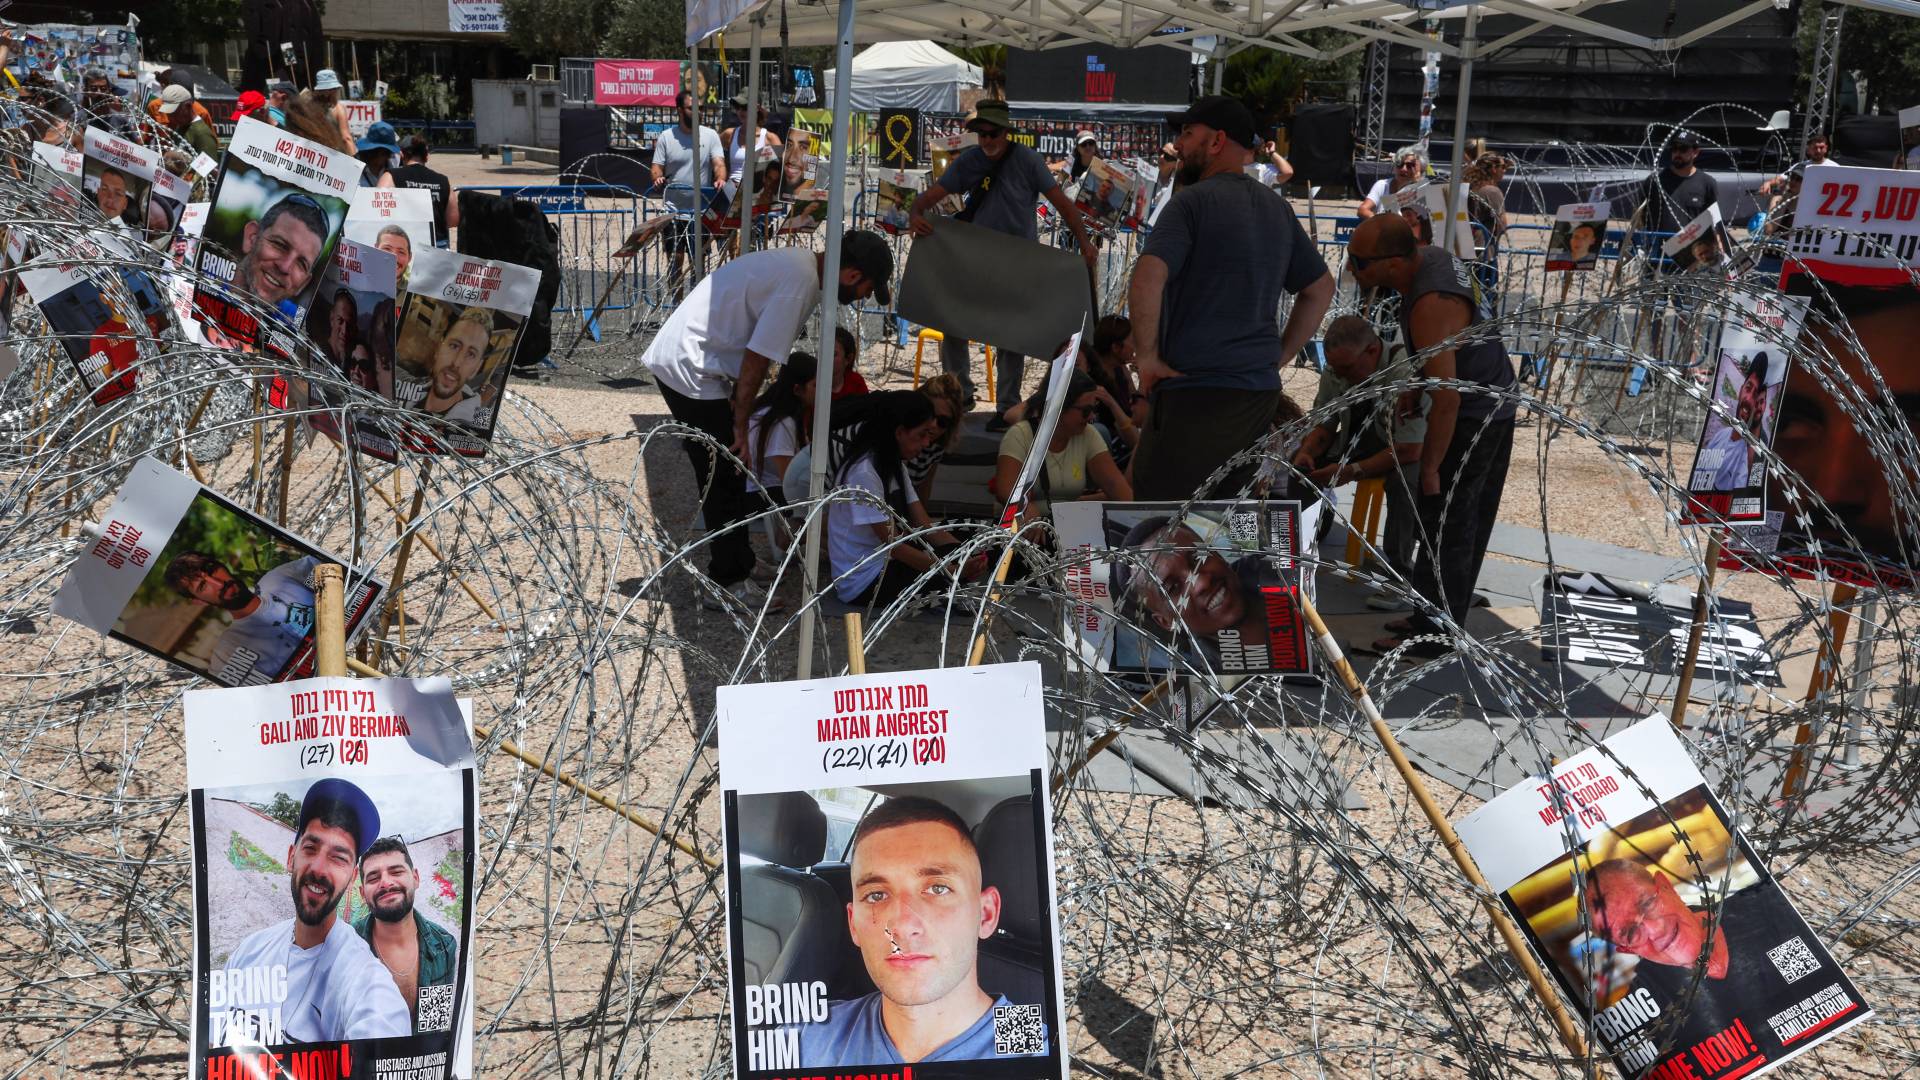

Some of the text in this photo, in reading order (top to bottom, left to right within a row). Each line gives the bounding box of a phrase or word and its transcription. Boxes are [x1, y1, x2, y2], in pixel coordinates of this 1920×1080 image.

[275, 138, 294, 157] (42)
[316, 152, 328, 169] טל
[1817, 182, 1859, 217] 22
[202, 251, 236, 281] BRING
[456, 273, 481, 289] ELKANA
[78, 351, 109, 376] BRING
[107, 526, 143, 569] GUY ILOUZ
[128, 546, 152, 567] (26)
[1260, 585, 1297, 669] HOME NOW!
[1218, 629, 1240, 670] BRING
[1244, 644, 1269, 670] HIM
[217, 647, 259, 687] BRING
[290, 690, 376, 719] גלי וזיו ברמן
[834, 684, 929, 714] מתן אנגרסט
[260, 715, 411, 746] GALI AND ZIV BERMAN
[817, 710, 949, 743] MATAN ANGREST
[300, 742, 335, 770] (27)
[1573, 775, 1620, 807] GODARD
[1578, 804, 1608, 830] (73)
[209, 964, 287, 1008] BRING
[746, 981, 828, 1026] BRING
[1595, 987, 1661, 1043] BRING
[1767, 983, 1843, 1029] HOSTAGES AND MISSING
[1774, 993, 1855, 1043] FAMILIES FORUM
[210, 1007, 282, 1049] THEM
[376, 1051, 447, 1072] HOSTAGES AND MISSING
[748, 1029, 800, 1071] HIM
[1698, 1017, 1758, 1077] NOW!
